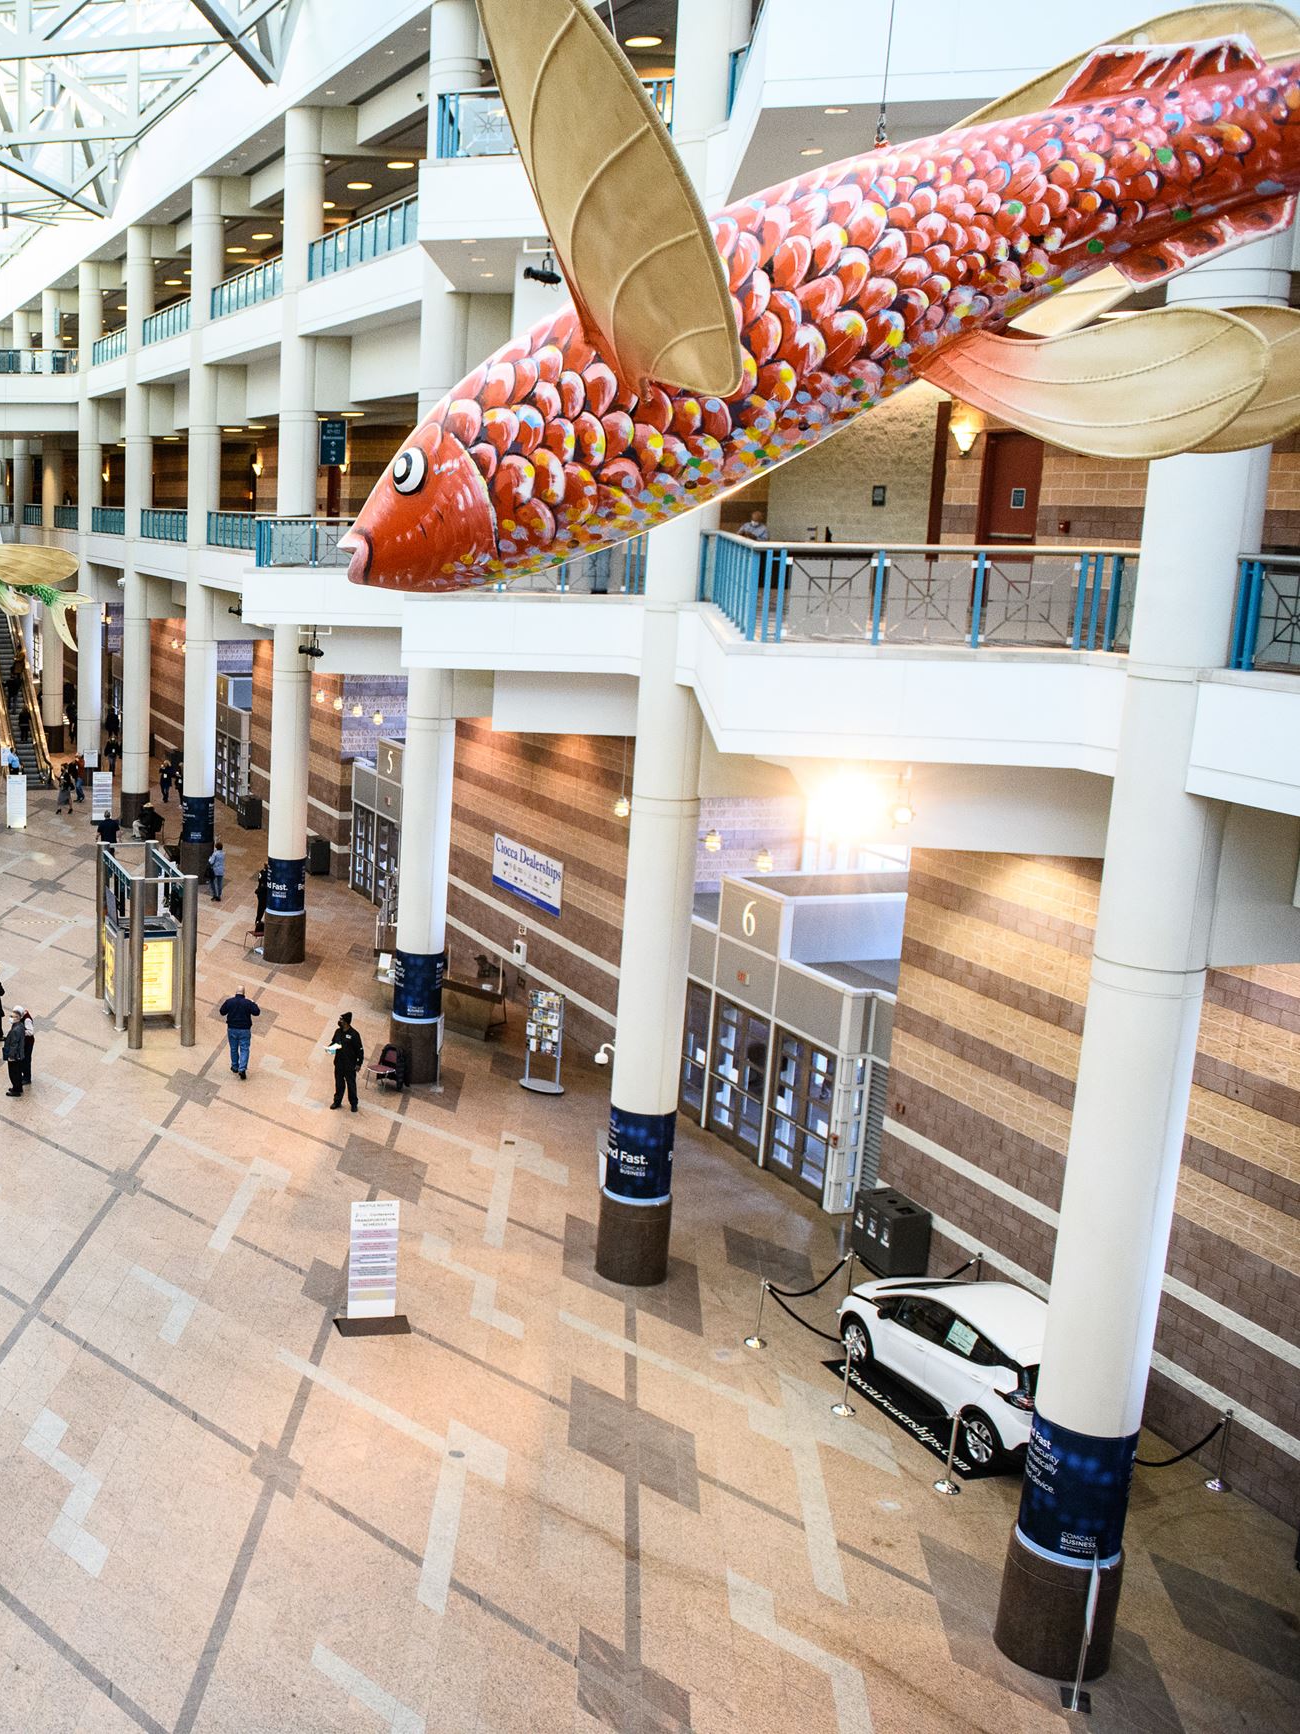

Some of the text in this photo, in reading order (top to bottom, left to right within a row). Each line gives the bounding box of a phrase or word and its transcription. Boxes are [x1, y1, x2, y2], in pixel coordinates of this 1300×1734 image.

[386, 750, 394, 774] 5
[495, 837, 562, 884] Ciocca Dealerships
[742, 900, 757, 937] 6
[619, 1150, 649, 1165] Fast.
[619, 1168, 646, 1177] BUSINESS
[620, 1163, 646, 1171] COMCAST
[1035, 1430, 1052, 1450] Fast
[1033, 1443, 1060, 1466] security
[1060, 1531, 1097, 1543] COMCAST
[1060, 1537, 1097, 1549] BUSINESS
[1059, 1545, 1081, 1554] BEYOND
